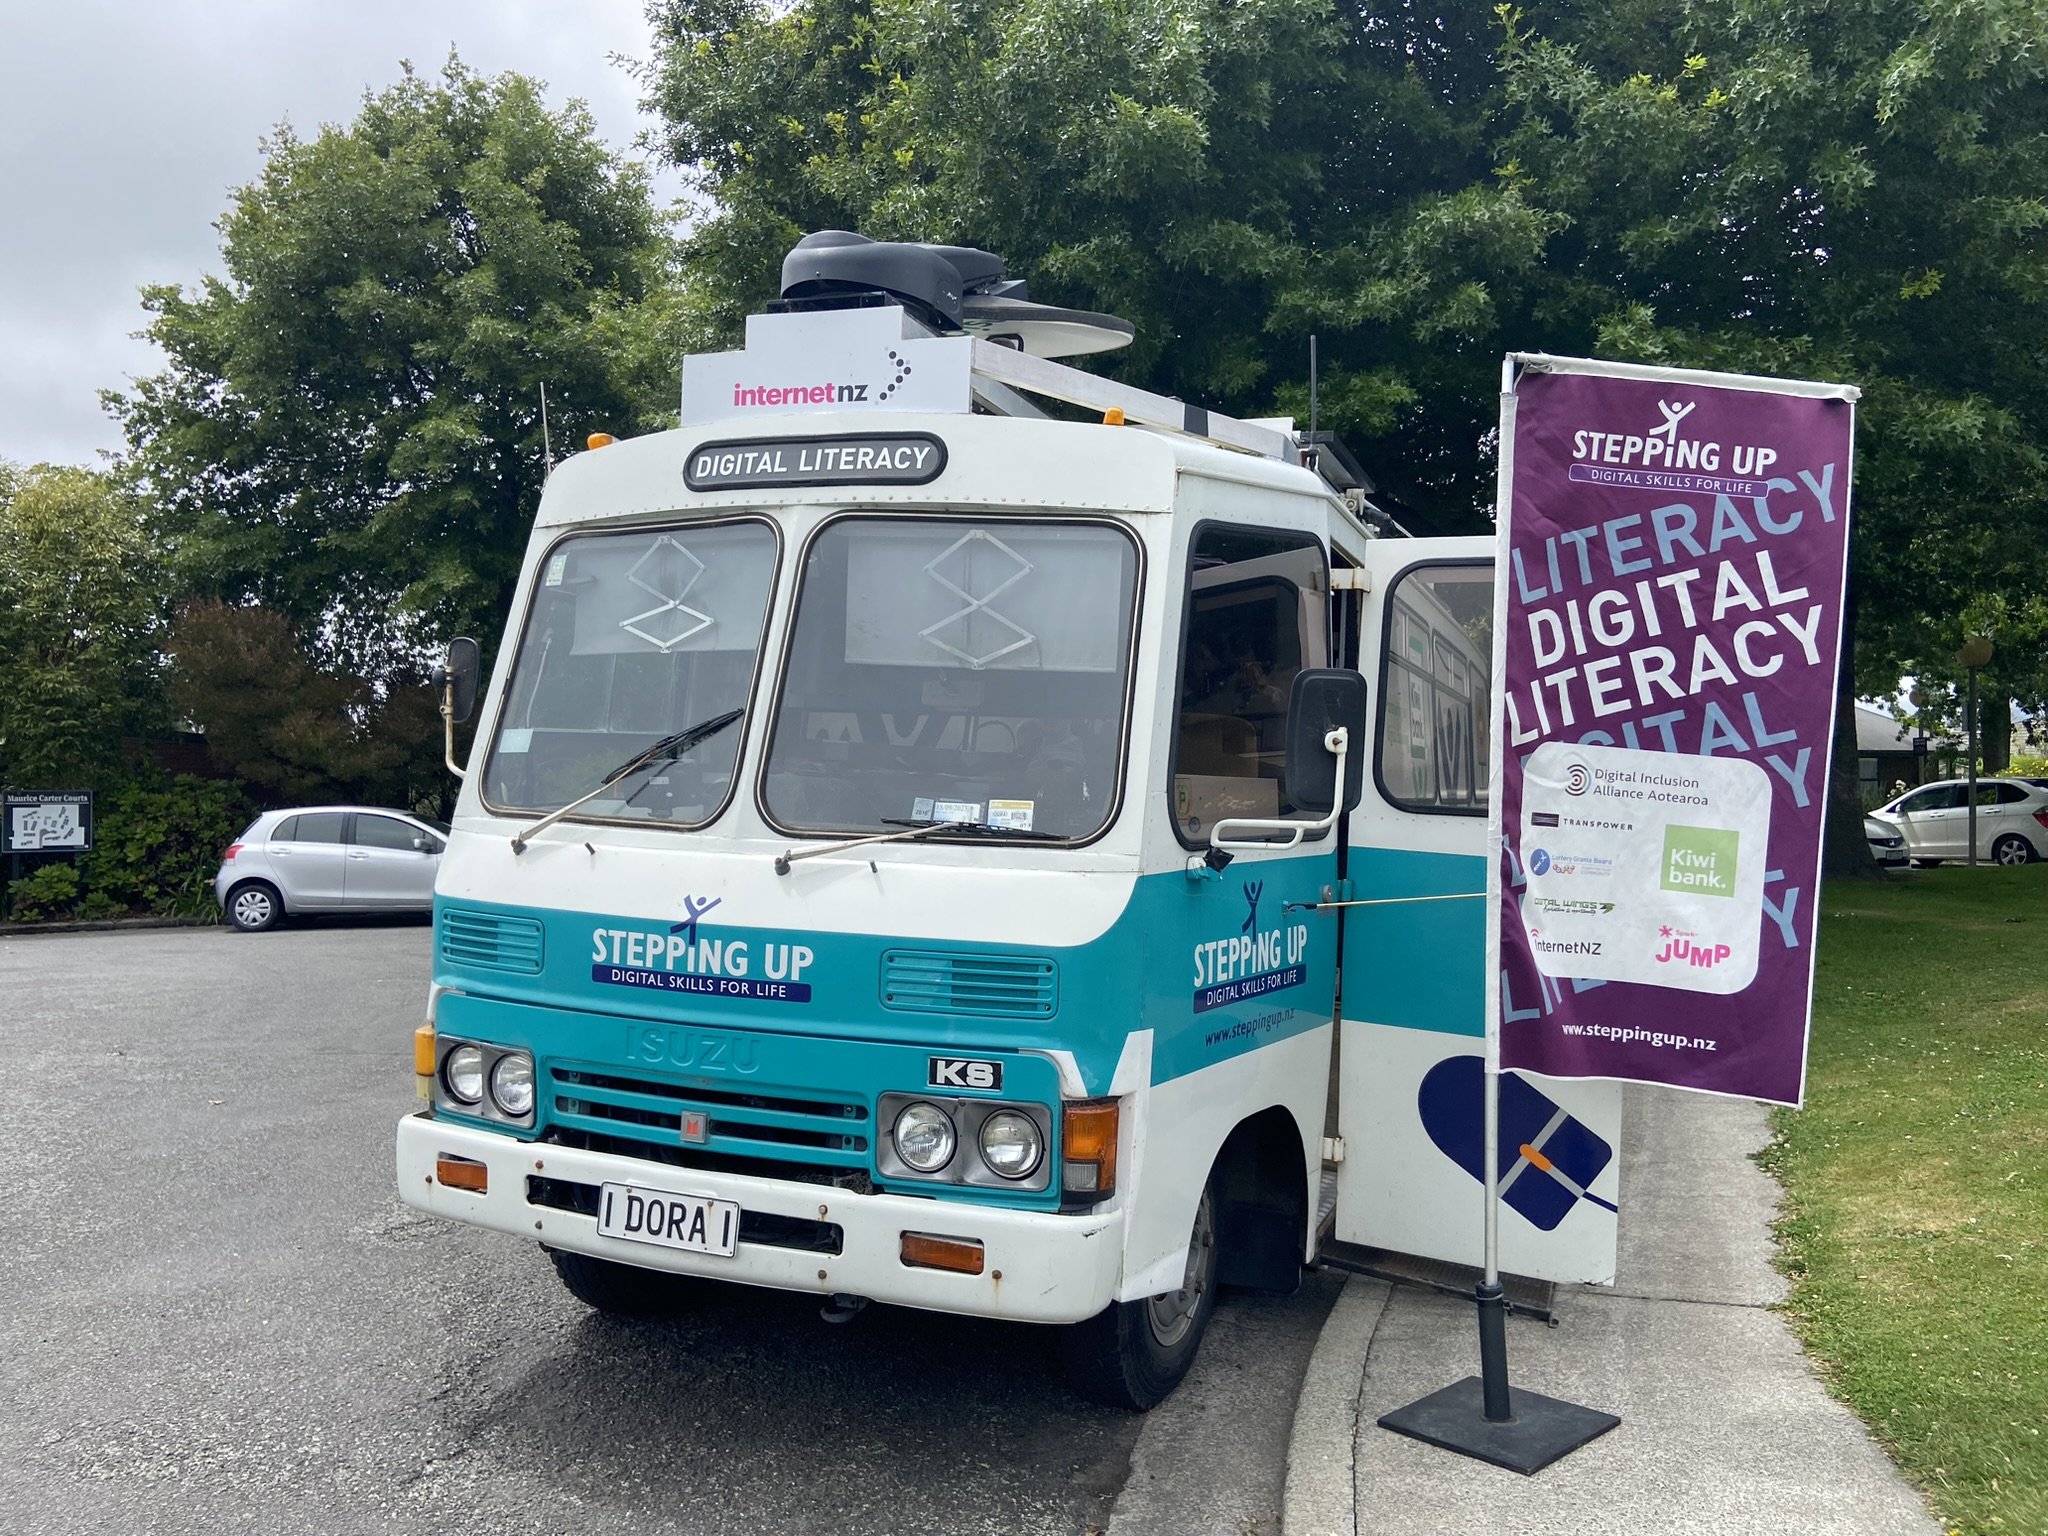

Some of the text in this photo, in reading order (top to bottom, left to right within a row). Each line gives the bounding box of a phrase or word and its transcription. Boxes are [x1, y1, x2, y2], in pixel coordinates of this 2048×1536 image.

[696, 447, 931, 478] DIGITAL LITERACY
[1732, 446, 1777, 476] UP
[1591, 469, 1752, 494] DIGITAL SKILLS FOR LIFE
[1512, 463, 1836, 604] LITERACY
[1527, 550, 1809, 669] DIGITAL
[1505, 604, 1823, 747] LITERACY
[1595, 769, 1699, 788] Digital Inclusion
[39, 794, 62, 802] Carter
[1593, 785, 1708, 806] Alliance Aotearoa
[1563, 818, 1633, 831] TRANSPOWER
[1670, 848, 1717, 869] Kiwi
[1669, 866, 1727, 889] bank.
[1287, 924, 1308, 965] UP
[1655, 939, 1731, 968] JUMP
[764, 943, 814, 981] UP
[611, 969, 786, 998] DIGITAL SKILLS FOR LIFE
[1207, 969, 1297, 1006] DIGITAL SKILLS FOR LIFE
[1205, 1007, 1295, 1047] www.steppingup.nz
[1562, 1022, 1717, 1051] www.steppingup.nz
[626, 1026, 761, 1073] ISUZU
